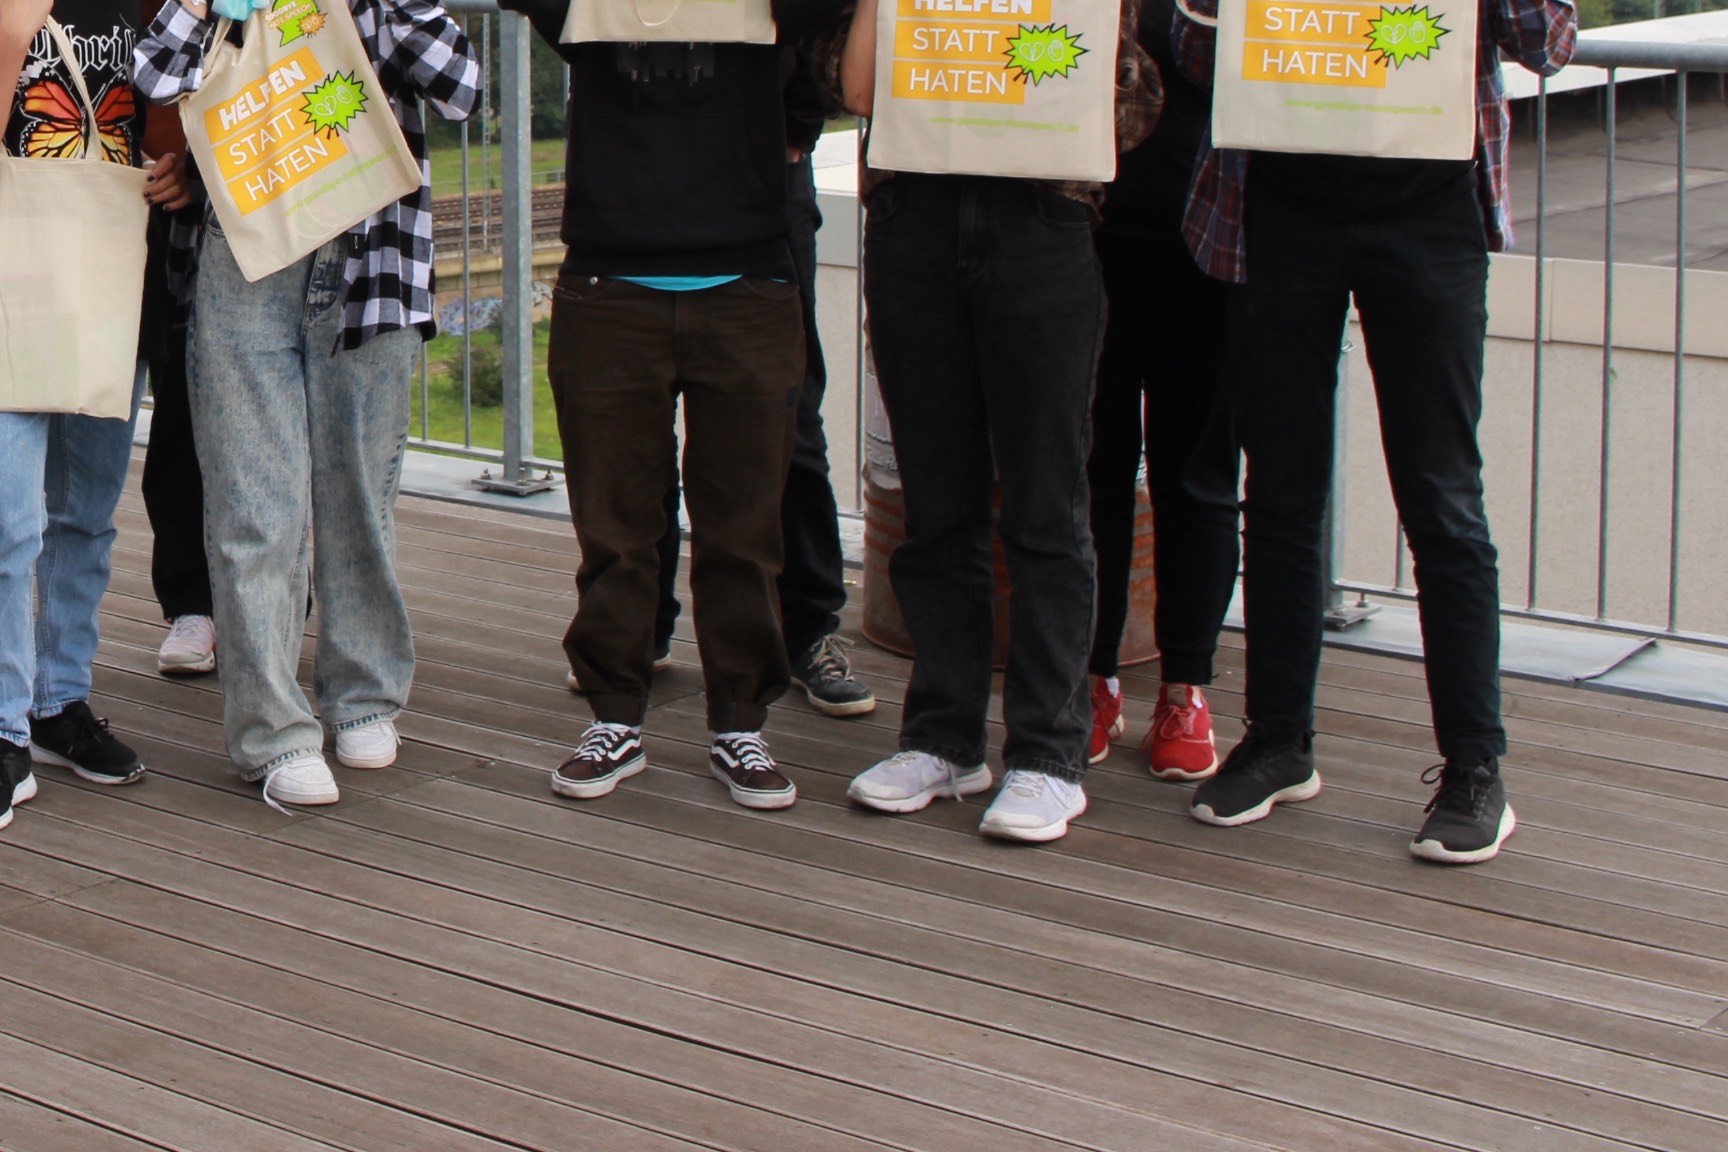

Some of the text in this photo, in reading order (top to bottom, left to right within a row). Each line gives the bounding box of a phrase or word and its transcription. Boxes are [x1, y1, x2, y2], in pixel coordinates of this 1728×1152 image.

[1264, 6, 1361, 36] STATT
[912, 27, 1000, 53] STATT
[1262, 48, 1368, 78] HATEN
[910, 68, 1007, 95] HATEN
[229, 108, 296, 166] STATT
[244, 136, 329, 201] HATEN
